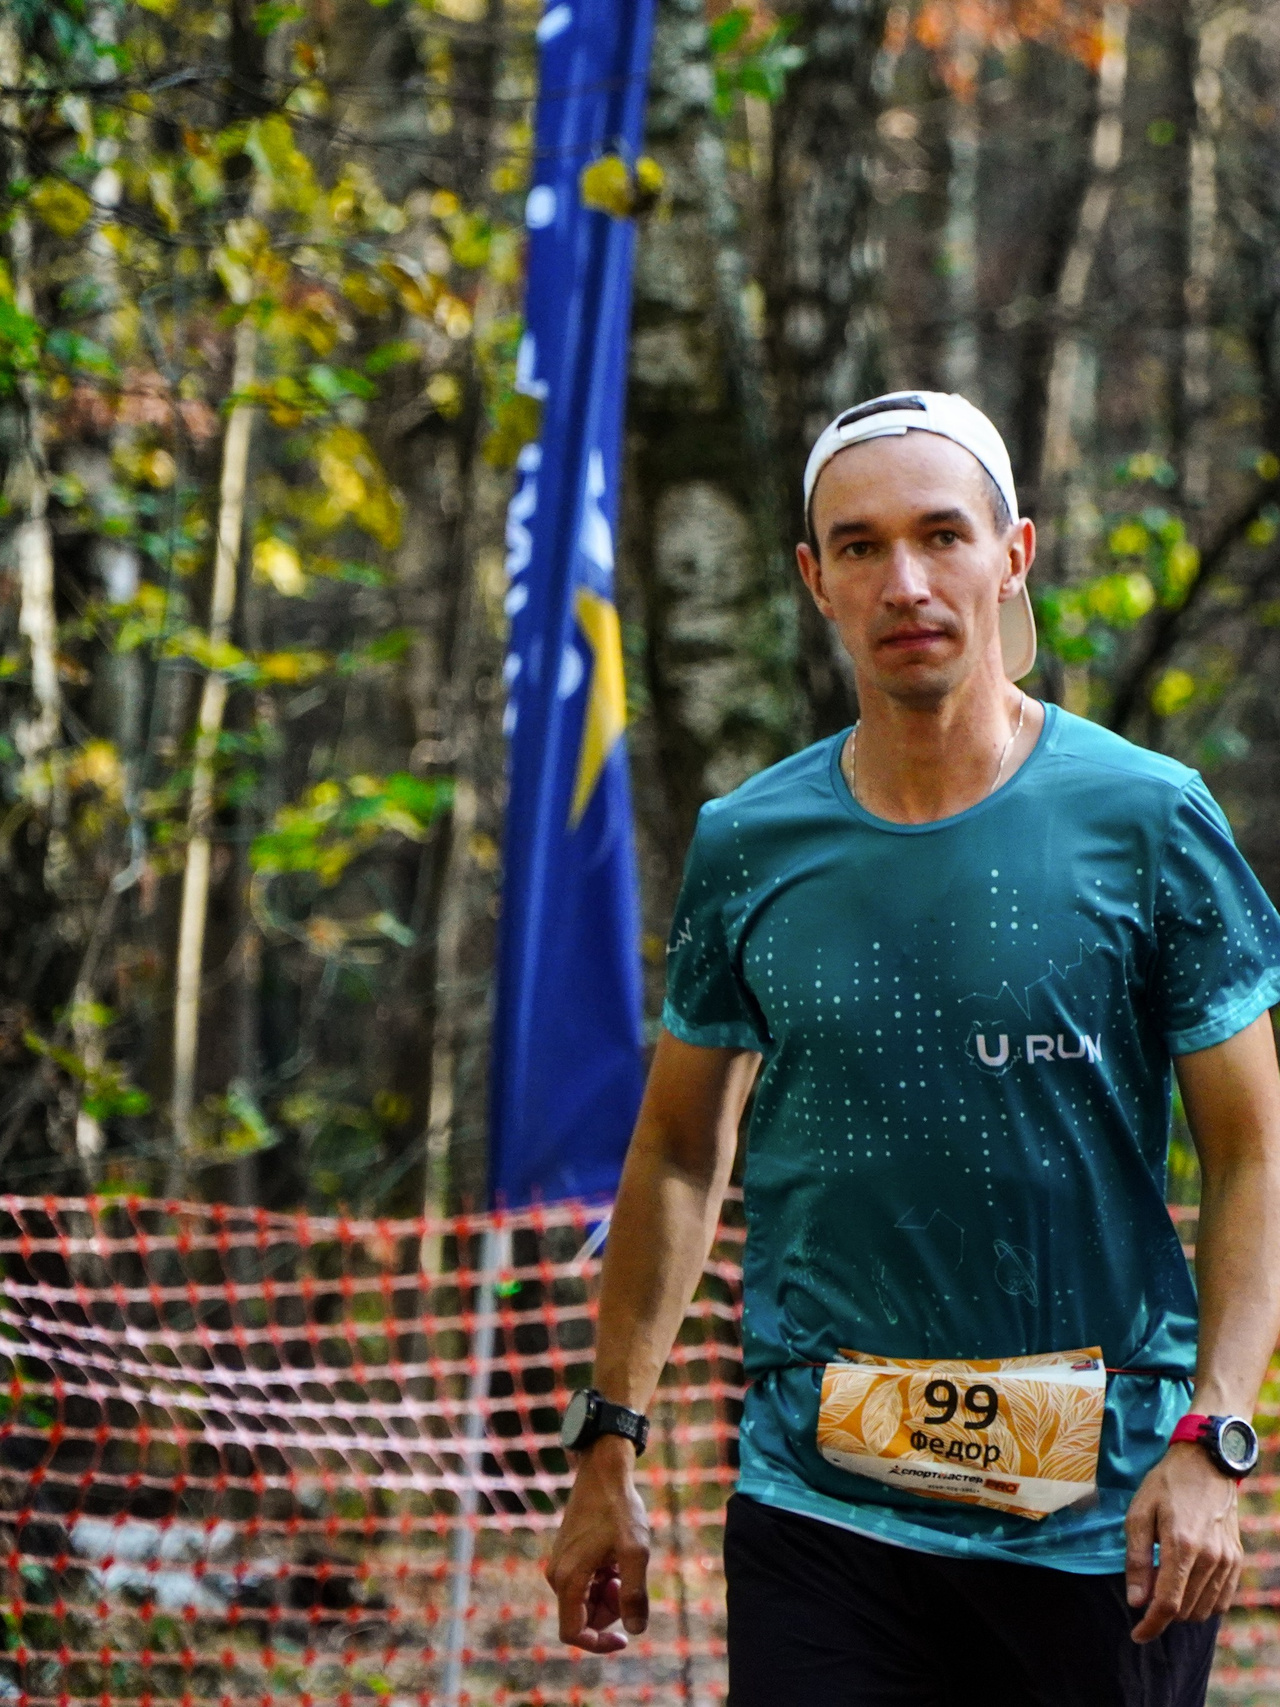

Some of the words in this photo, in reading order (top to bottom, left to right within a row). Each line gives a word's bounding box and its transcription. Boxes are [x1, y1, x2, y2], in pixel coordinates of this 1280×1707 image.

[976, 1034, 1009, 1066] U
[1026, 1033, 1102, 1064] RUN
[924, 1379, 998, 1429] 99
[910, 1430, 1000, 1468] Федор
